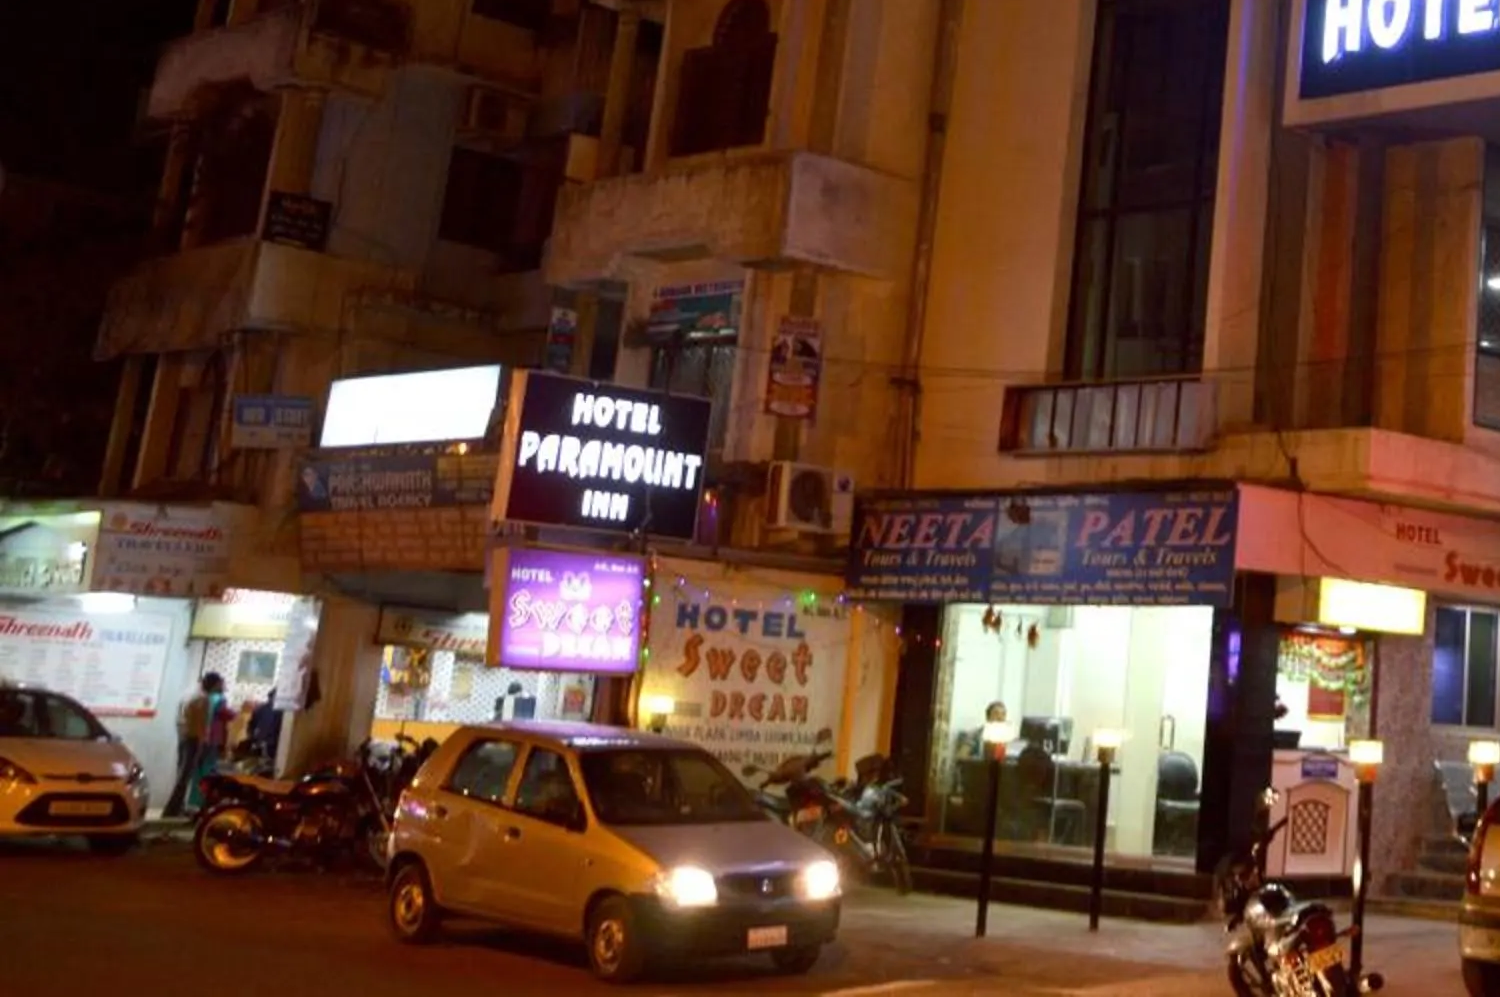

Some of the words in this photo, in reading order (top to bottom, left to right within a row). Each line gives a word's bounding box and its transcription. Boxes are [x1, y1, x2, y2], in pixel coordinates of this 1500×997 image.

[571, 392, 662, 435] HOTEL
[518, 430, 703, 490] PARAMOUNT
[580, 489, 630, 522] INN
[855, 511, 993, 549] NEETA
[1075, 506, 1231, 548] PATEL
[1396, 523, 1442, 545] HOTEL
[511, 567, 554, 583] HOTEL
[508, 589, 633, 638] Sweet
[676, 604, 806, 640] HOTEL
[677, 633, 814, 687] Sweet
[709, 689, 809, 724] DREAM
